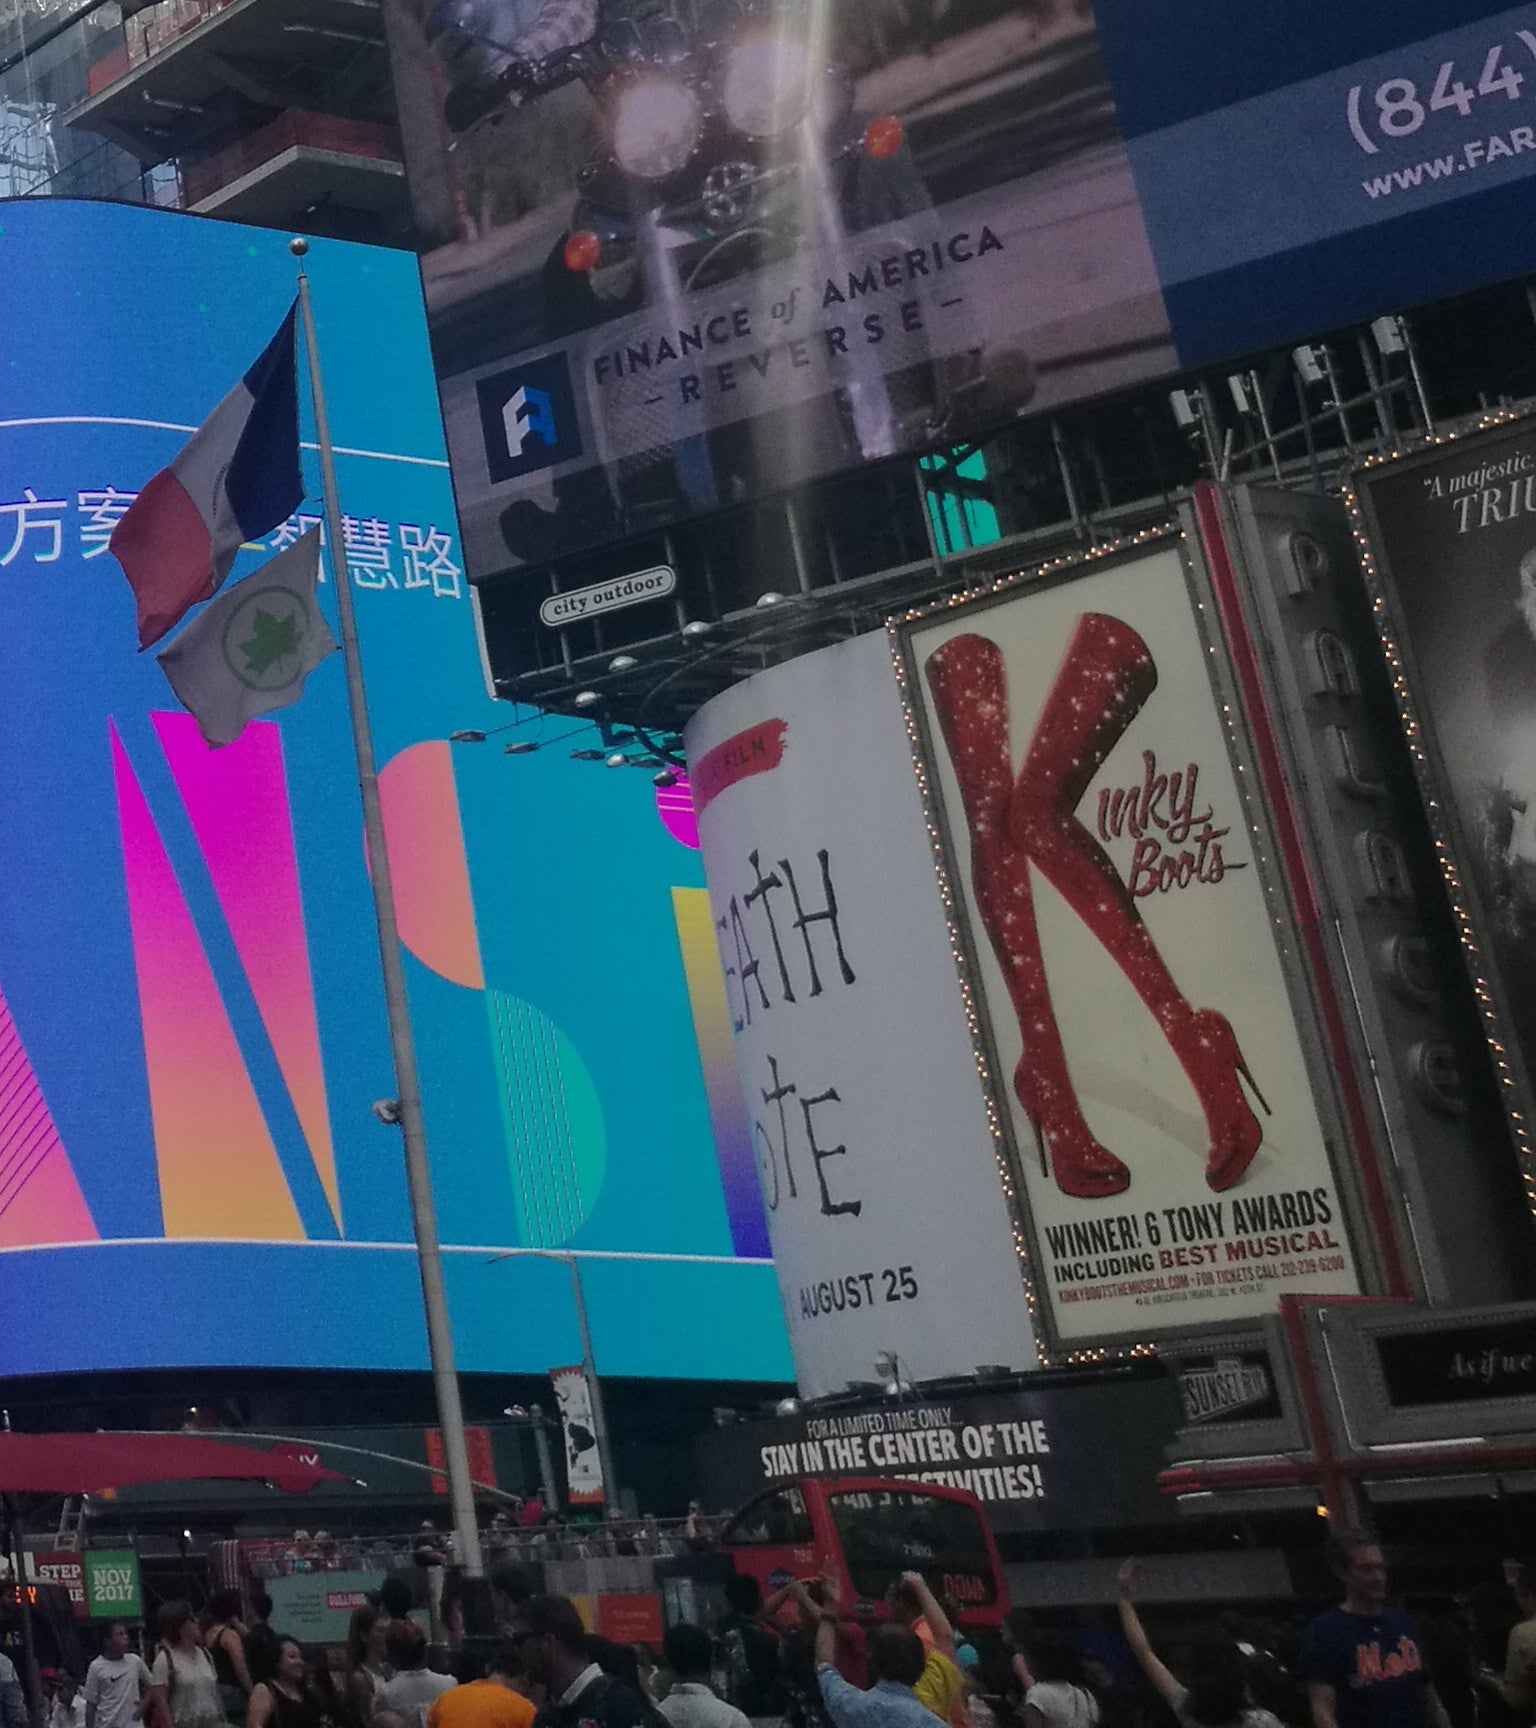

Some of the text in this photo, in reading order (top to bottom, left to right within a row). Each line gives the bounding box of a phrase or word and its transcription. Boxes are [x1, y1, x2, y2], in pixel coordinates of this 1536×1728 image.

[592, 224, 1005, 385] FINANCE of AMERICA
[680, 298, 924, 404] REVERSE
[554, 575, 663, 615] city outdoor
[1128, 822, 1248, 899] Boots
[1045, 1187, 1331, 1259] WINNER! 6 TONY AWARDS
[1054, 1229, 1339, 1283] INCLUDING BEST MUSICAL
[800, 1267, 919, 1320] AUGUST 25
[1185, 1371, 1241, 1417] SUNSET
[760, 1419, 1050, 1477] STAY IN THE CENTER OF THE
[806, 1409, 917, 1439] FOR A LIMITED TIME
[40, 1563, 81, 1580] STEP
[92, 1570, 133, 1585] NOV
[95, 1585, 134, 1601] 2017
